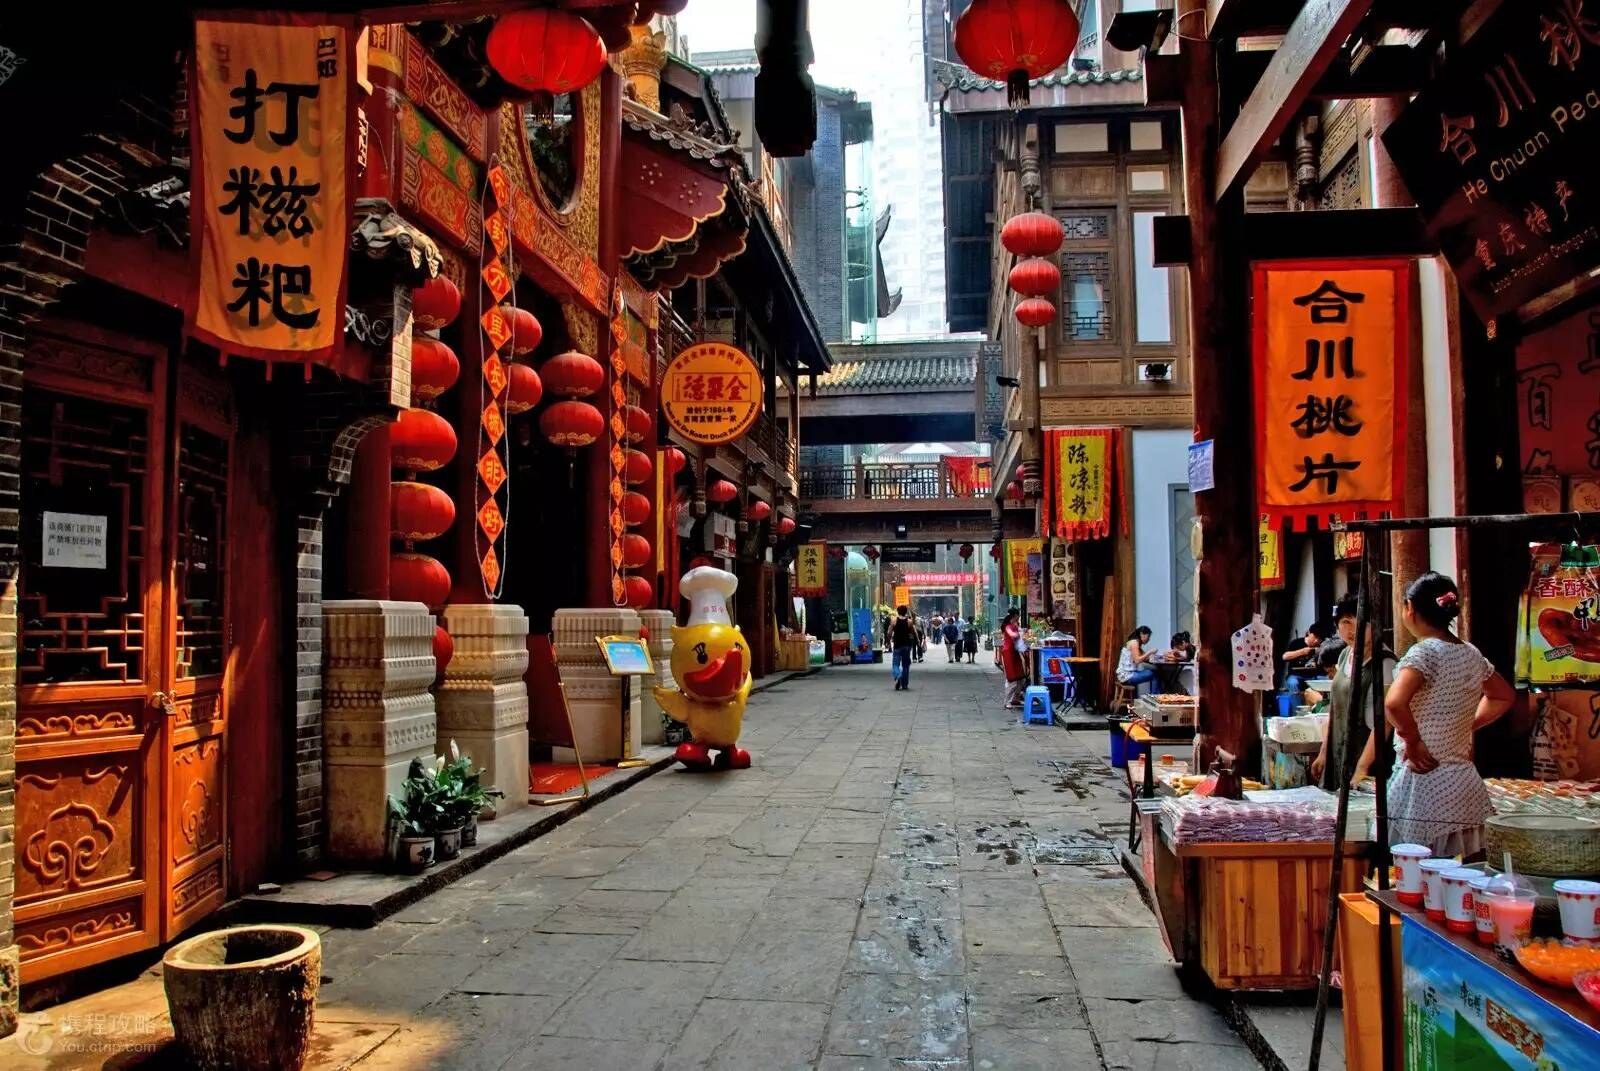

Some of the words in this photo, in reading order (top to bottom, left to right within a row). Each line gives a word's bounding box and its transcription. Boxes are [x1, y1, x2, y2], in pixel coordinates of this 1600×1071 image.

[219, 68, 322, 330] 打糍粑
[1462, 178, 1488, 204] He
[1490, 130, 1550, 181] Chuan
[1287, 279, 1366, 495] 合川桃片
[1535, 577, 1594, 600] 香酥
